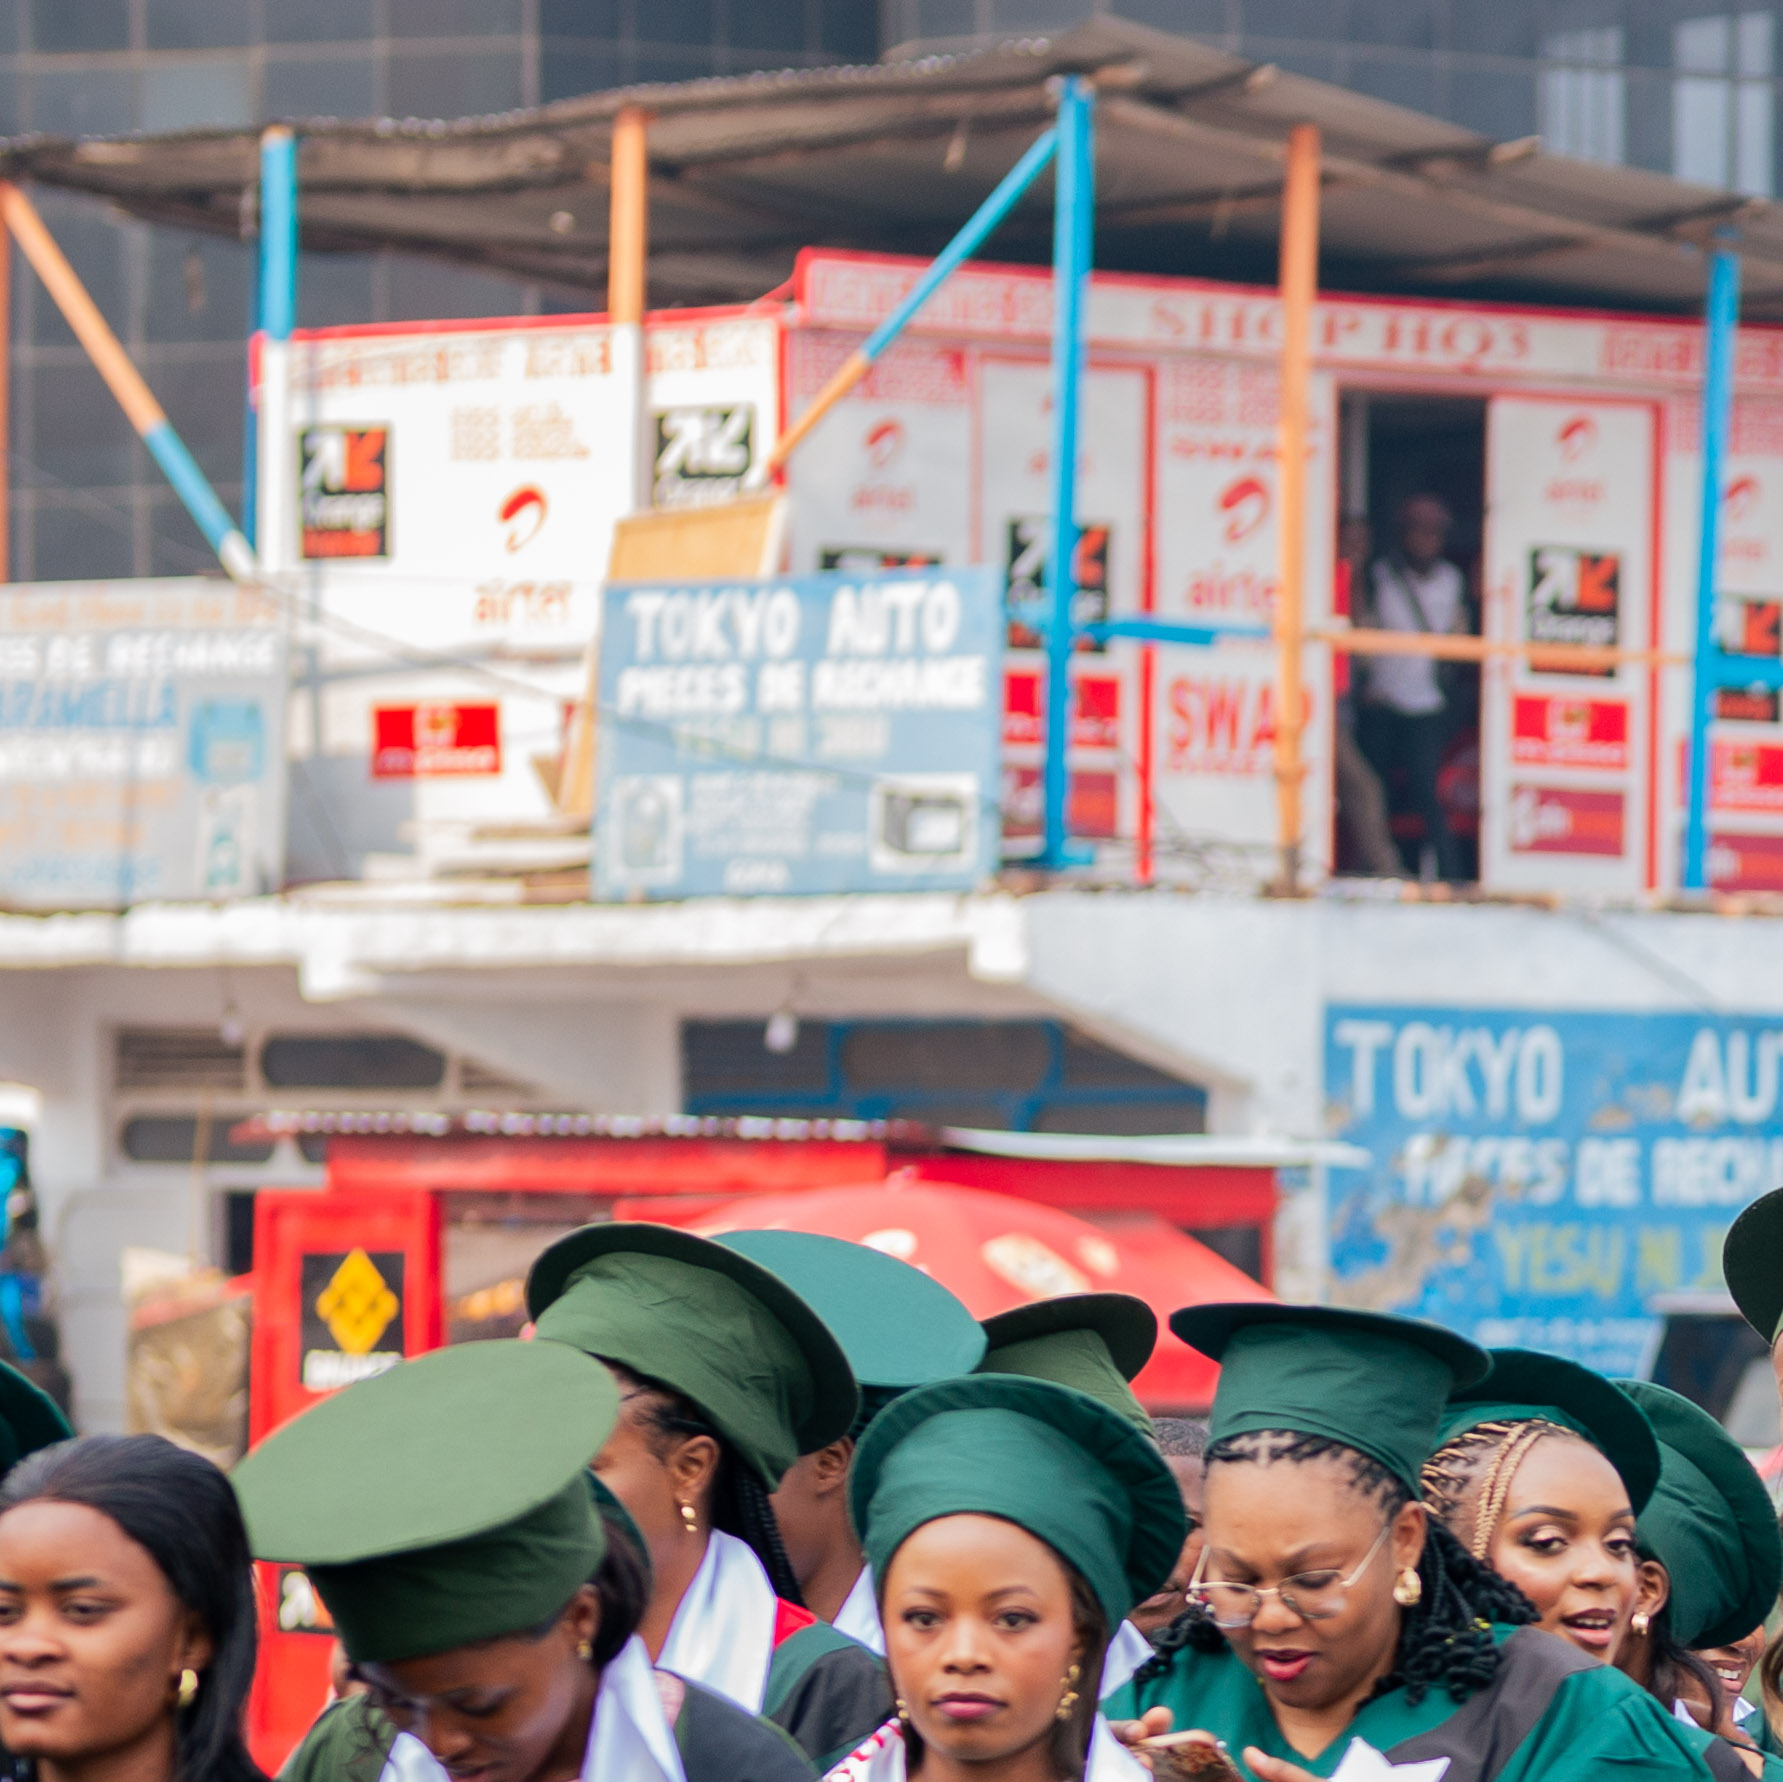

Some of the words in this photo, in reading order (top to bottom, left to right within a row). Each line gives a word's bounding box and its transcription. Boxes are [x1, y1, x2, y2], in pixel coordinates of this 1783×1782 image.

[624, 587, 800, 660] TOKYO
[826, 580, 962, 655] AUTO
[1189, 565, 1280, 609] airte
[1335, 1020, 1563, 1123] TOKYO
[1576, 1138, 1641, 1207] DE
